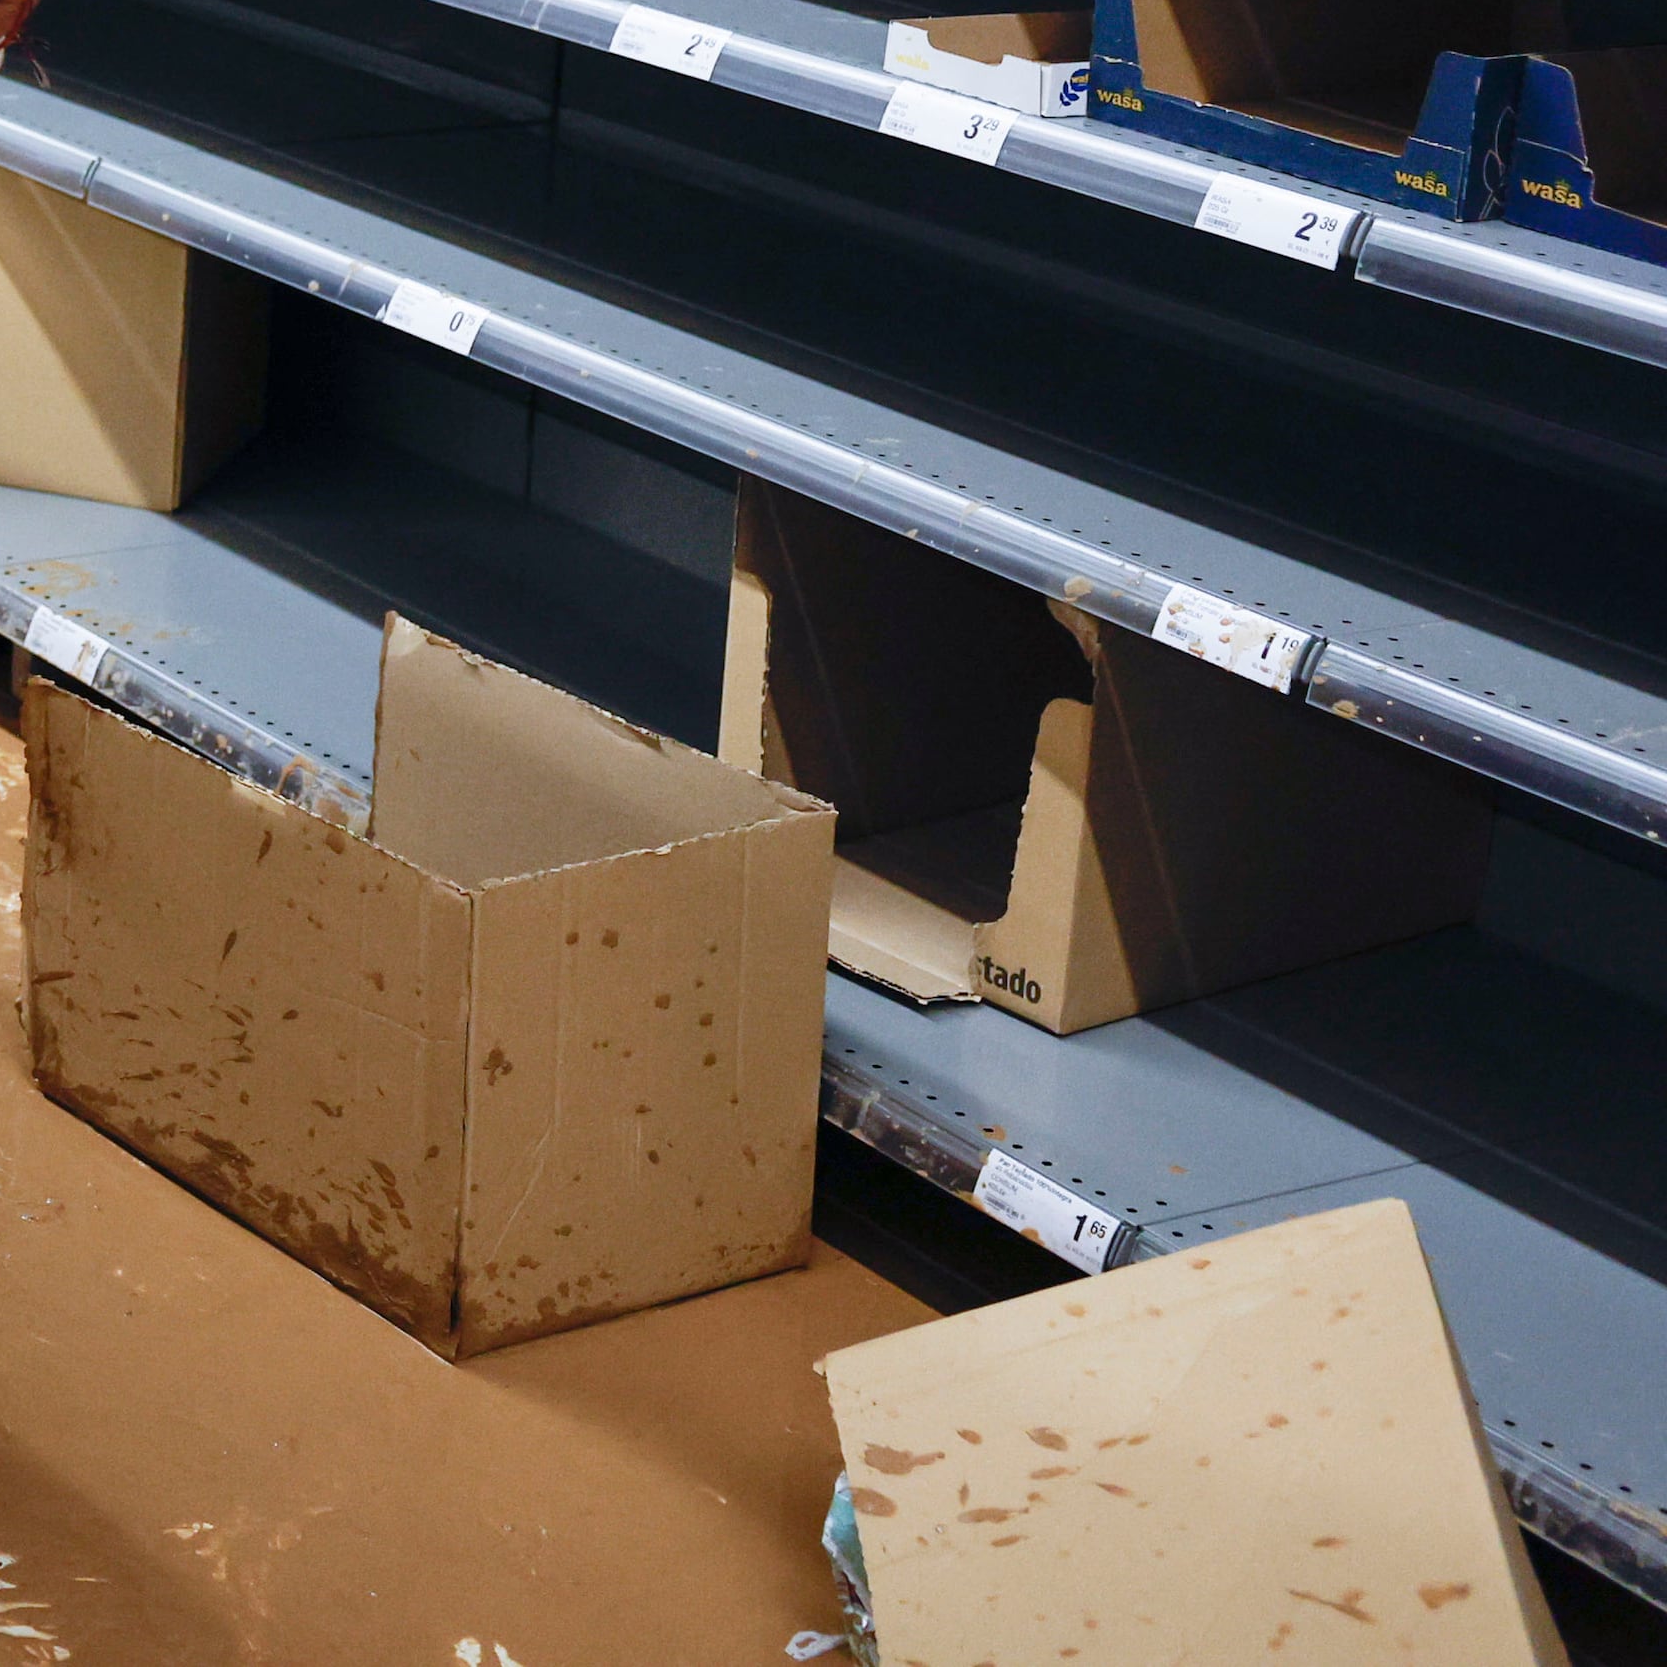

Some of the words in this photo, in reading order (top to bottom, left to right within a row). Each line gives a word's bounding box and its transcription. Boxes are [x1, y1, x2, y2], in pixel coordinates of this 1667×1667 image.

[683, 33, 703, 56] 2
[1096, 88, 1143, 113] wasa
[963, 113, 984, 140] 3
[983, 117, 1001, 132] 29
[1395, 169, 1449, 198] wasa
[1521, 177, 1583, 210] wasa
[1293, 211, 1318, 242] 2
[1318, 215, 1339, 233] 39
[449, 310, 465, 333] 0
[977, 955, 1042, 1005] tado
[1073, 1214, 1088, 1243] 1
[1089, 1220, 1108, 1240] 65
